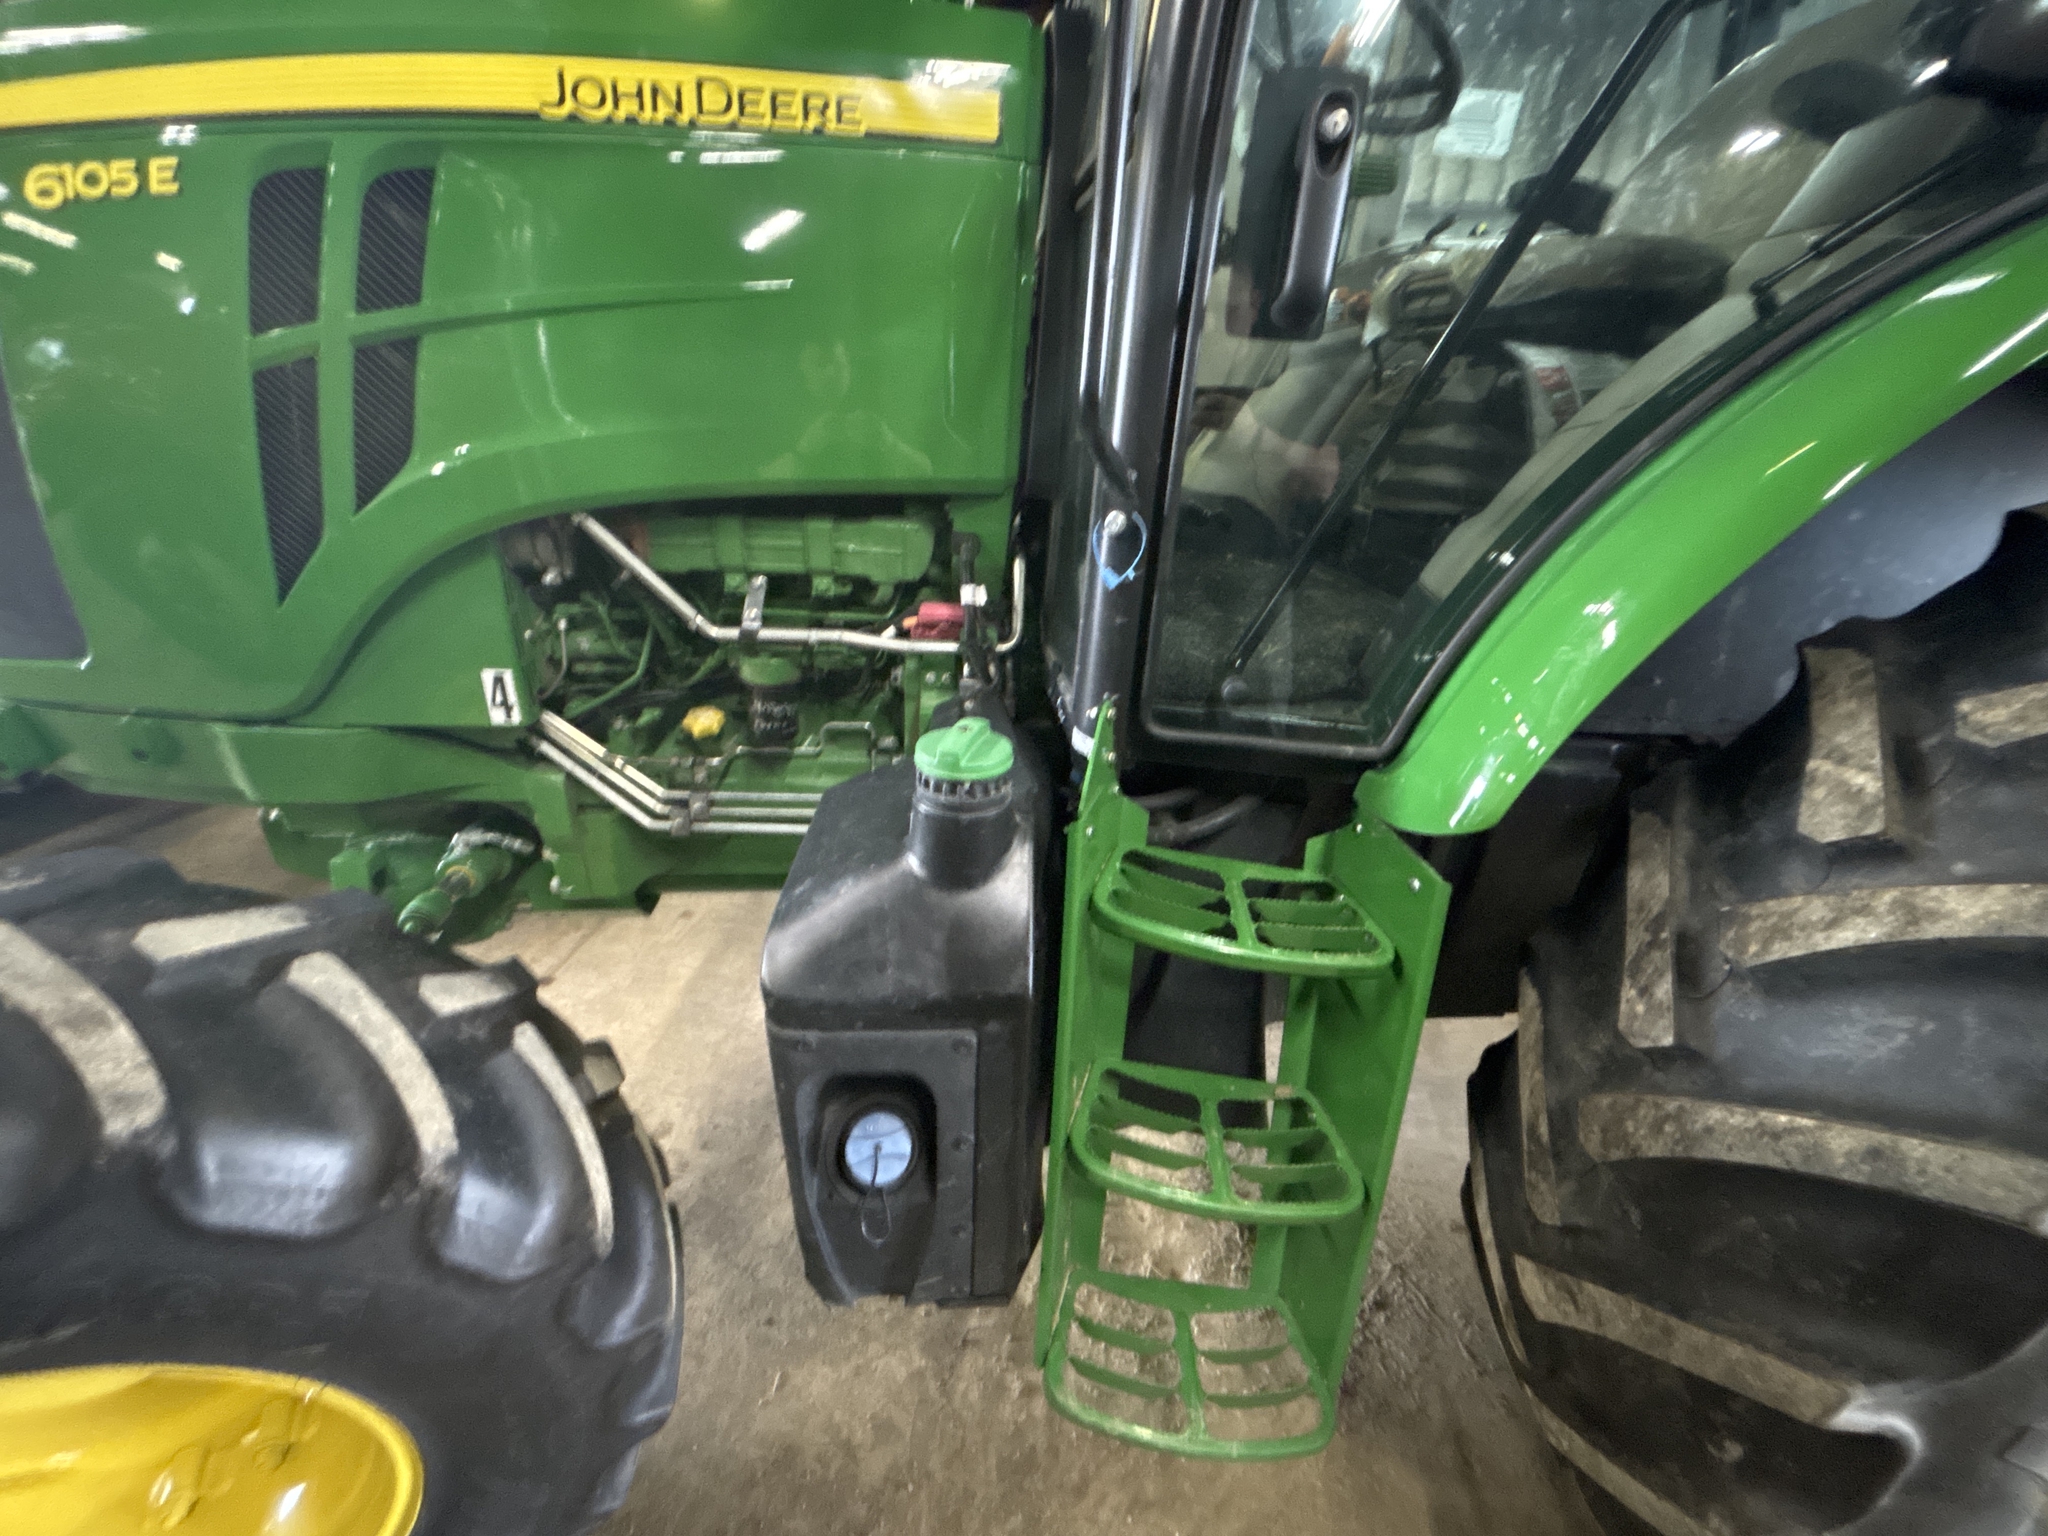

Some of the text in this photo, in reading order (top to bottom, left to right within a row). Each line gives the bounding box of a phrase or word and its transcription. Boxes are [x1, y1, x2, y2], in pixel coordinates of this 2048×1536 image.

[539, 65, 866, 135] JOHN DEERE
[491, 671, 513, 721] 4
